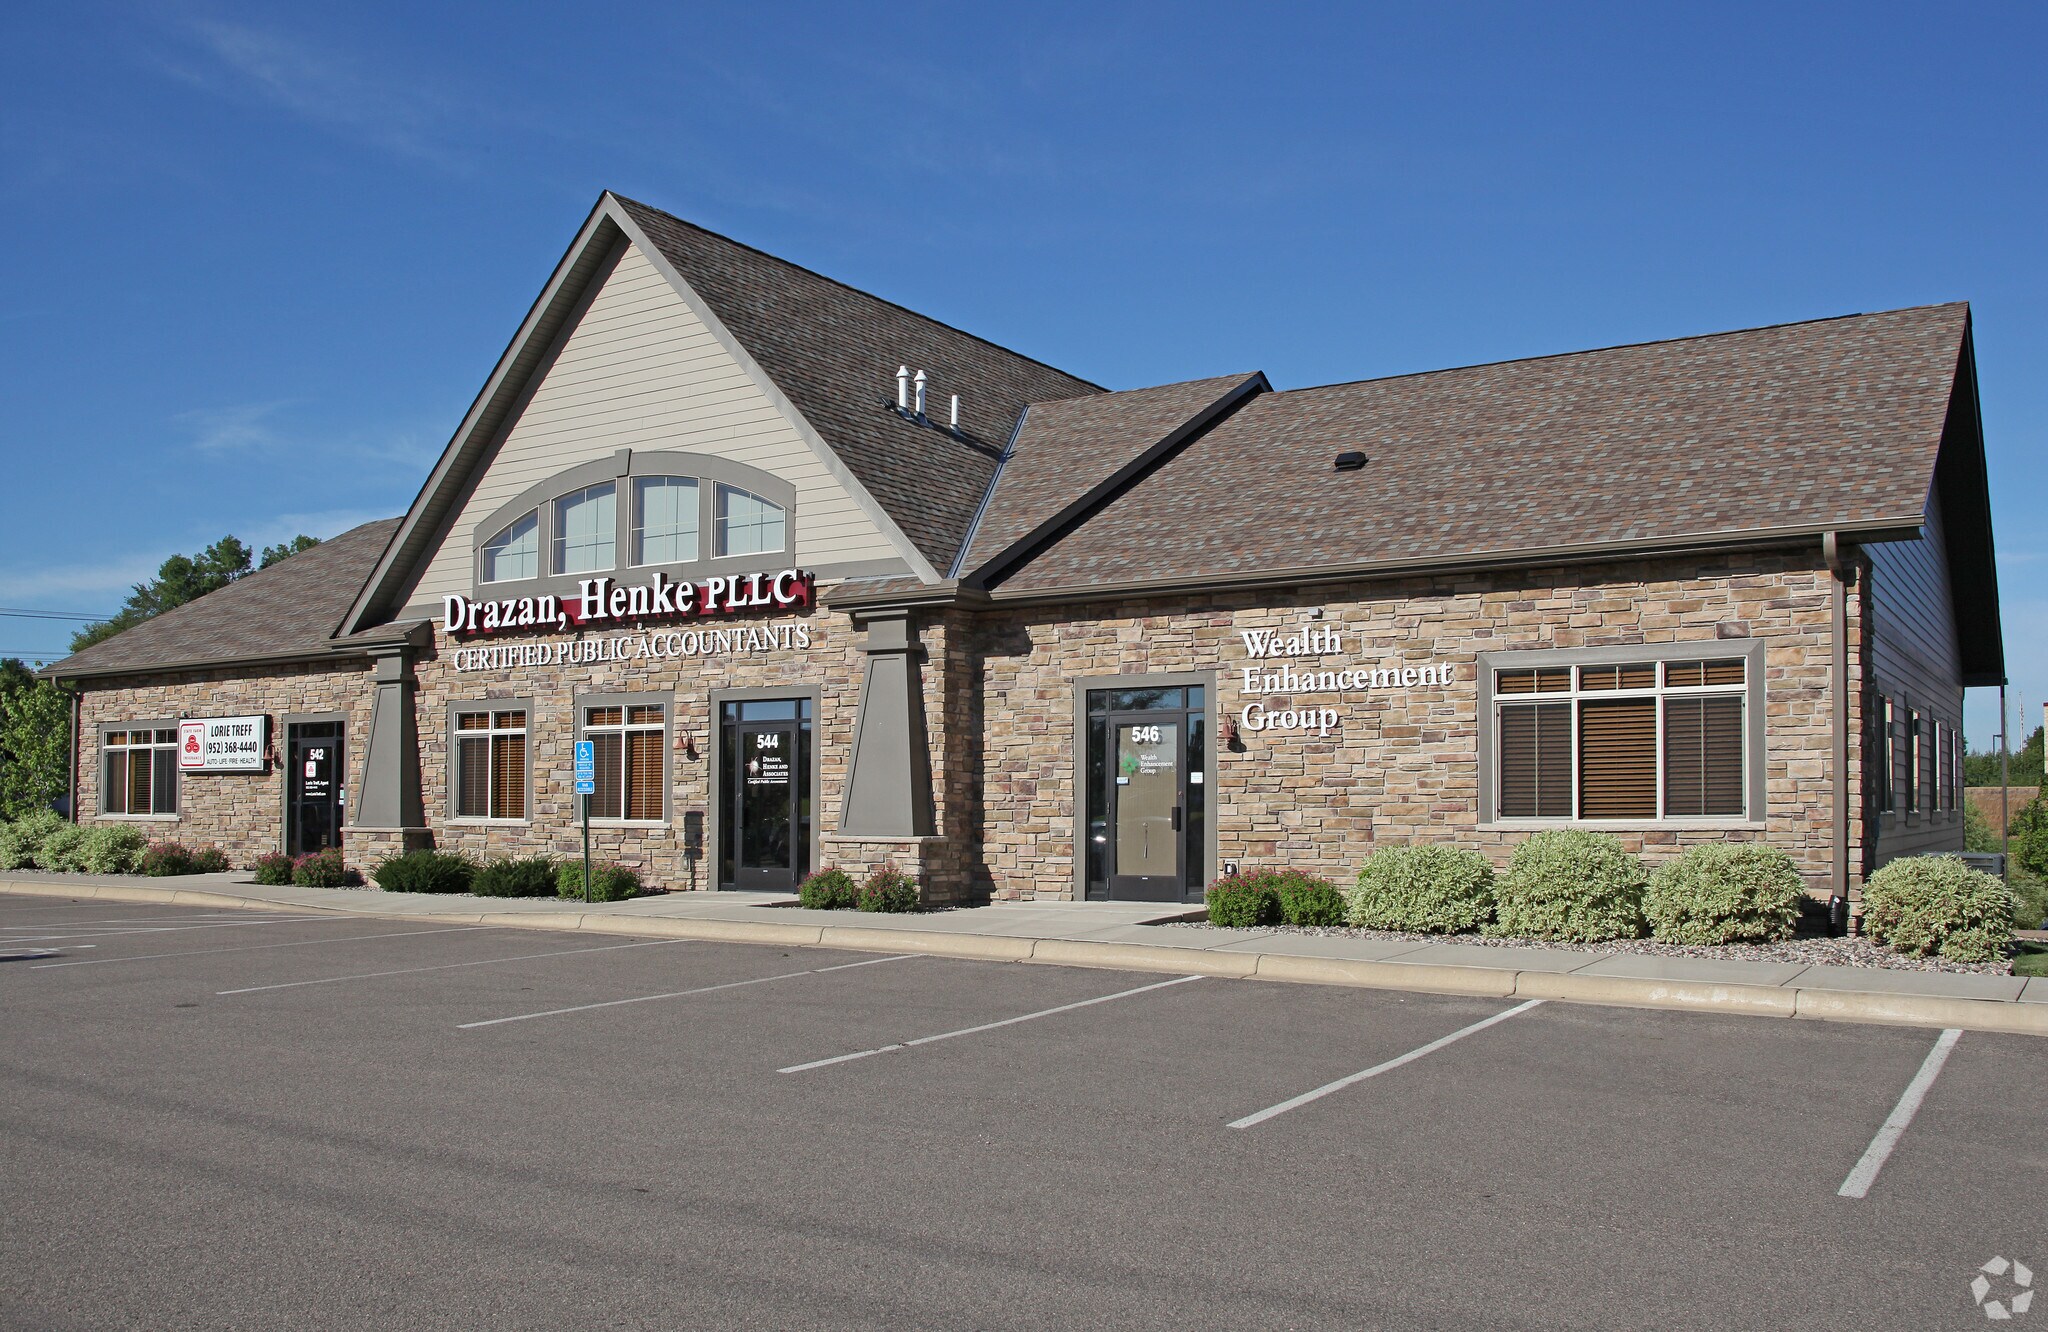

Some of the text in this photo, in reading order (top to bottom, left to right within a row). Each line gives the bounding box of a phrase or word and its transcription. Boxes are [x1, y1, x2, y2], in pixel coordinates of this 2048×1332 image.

[441, 569, 798, 632] Drazan, Henke PLLC
[454, 622, 810, 671] CERTIFIED PUBLIC ACCOUNTANTS
[1240, 625, 1342, 659] Wealth
[1241, 660, 1453, 694] Enhancement
[211, 724, 252, 737] LORIE TREFF
[1241, 703, 1339, 737] Group
[757, 734, 778, 749] 544
[1132, 726, 1159, 742] 546
[206, 741, 258, 755] (952) 368-4440
[310, 748, 324, 760] 542
